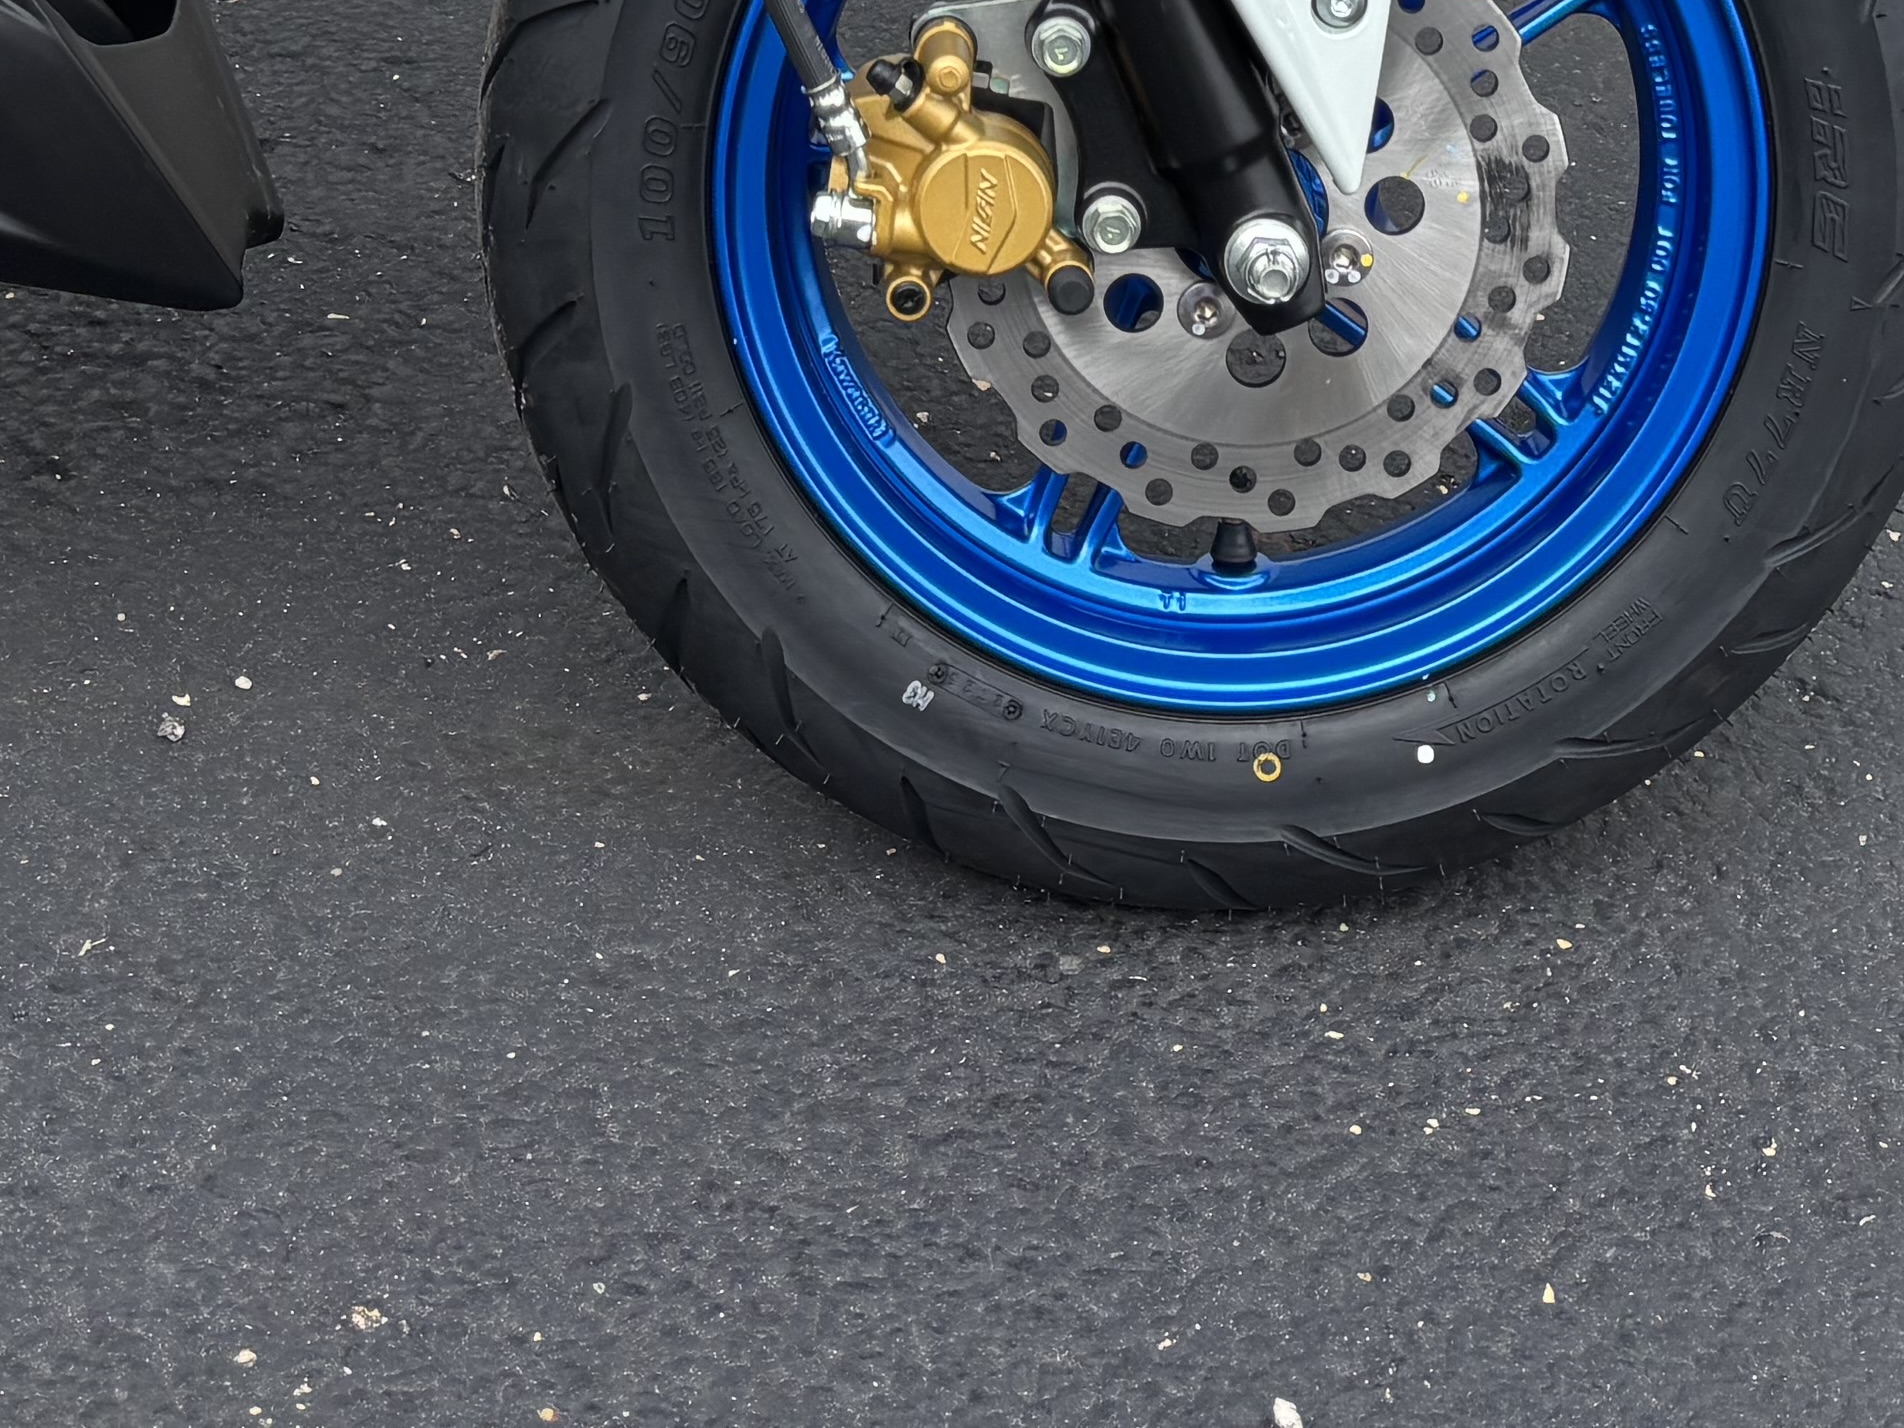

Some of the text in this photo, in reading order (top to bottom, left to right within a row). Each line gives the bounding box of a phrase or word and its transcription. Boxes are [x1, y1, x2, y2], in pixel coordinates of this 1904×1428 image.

[820, 346, 888, 442] Kawasaki
[1591, 595, 1652, 641] WHEEL
[1605, 608, 1664, 662] FRONT
[1456, 660, 1588, 744] ROTATION
